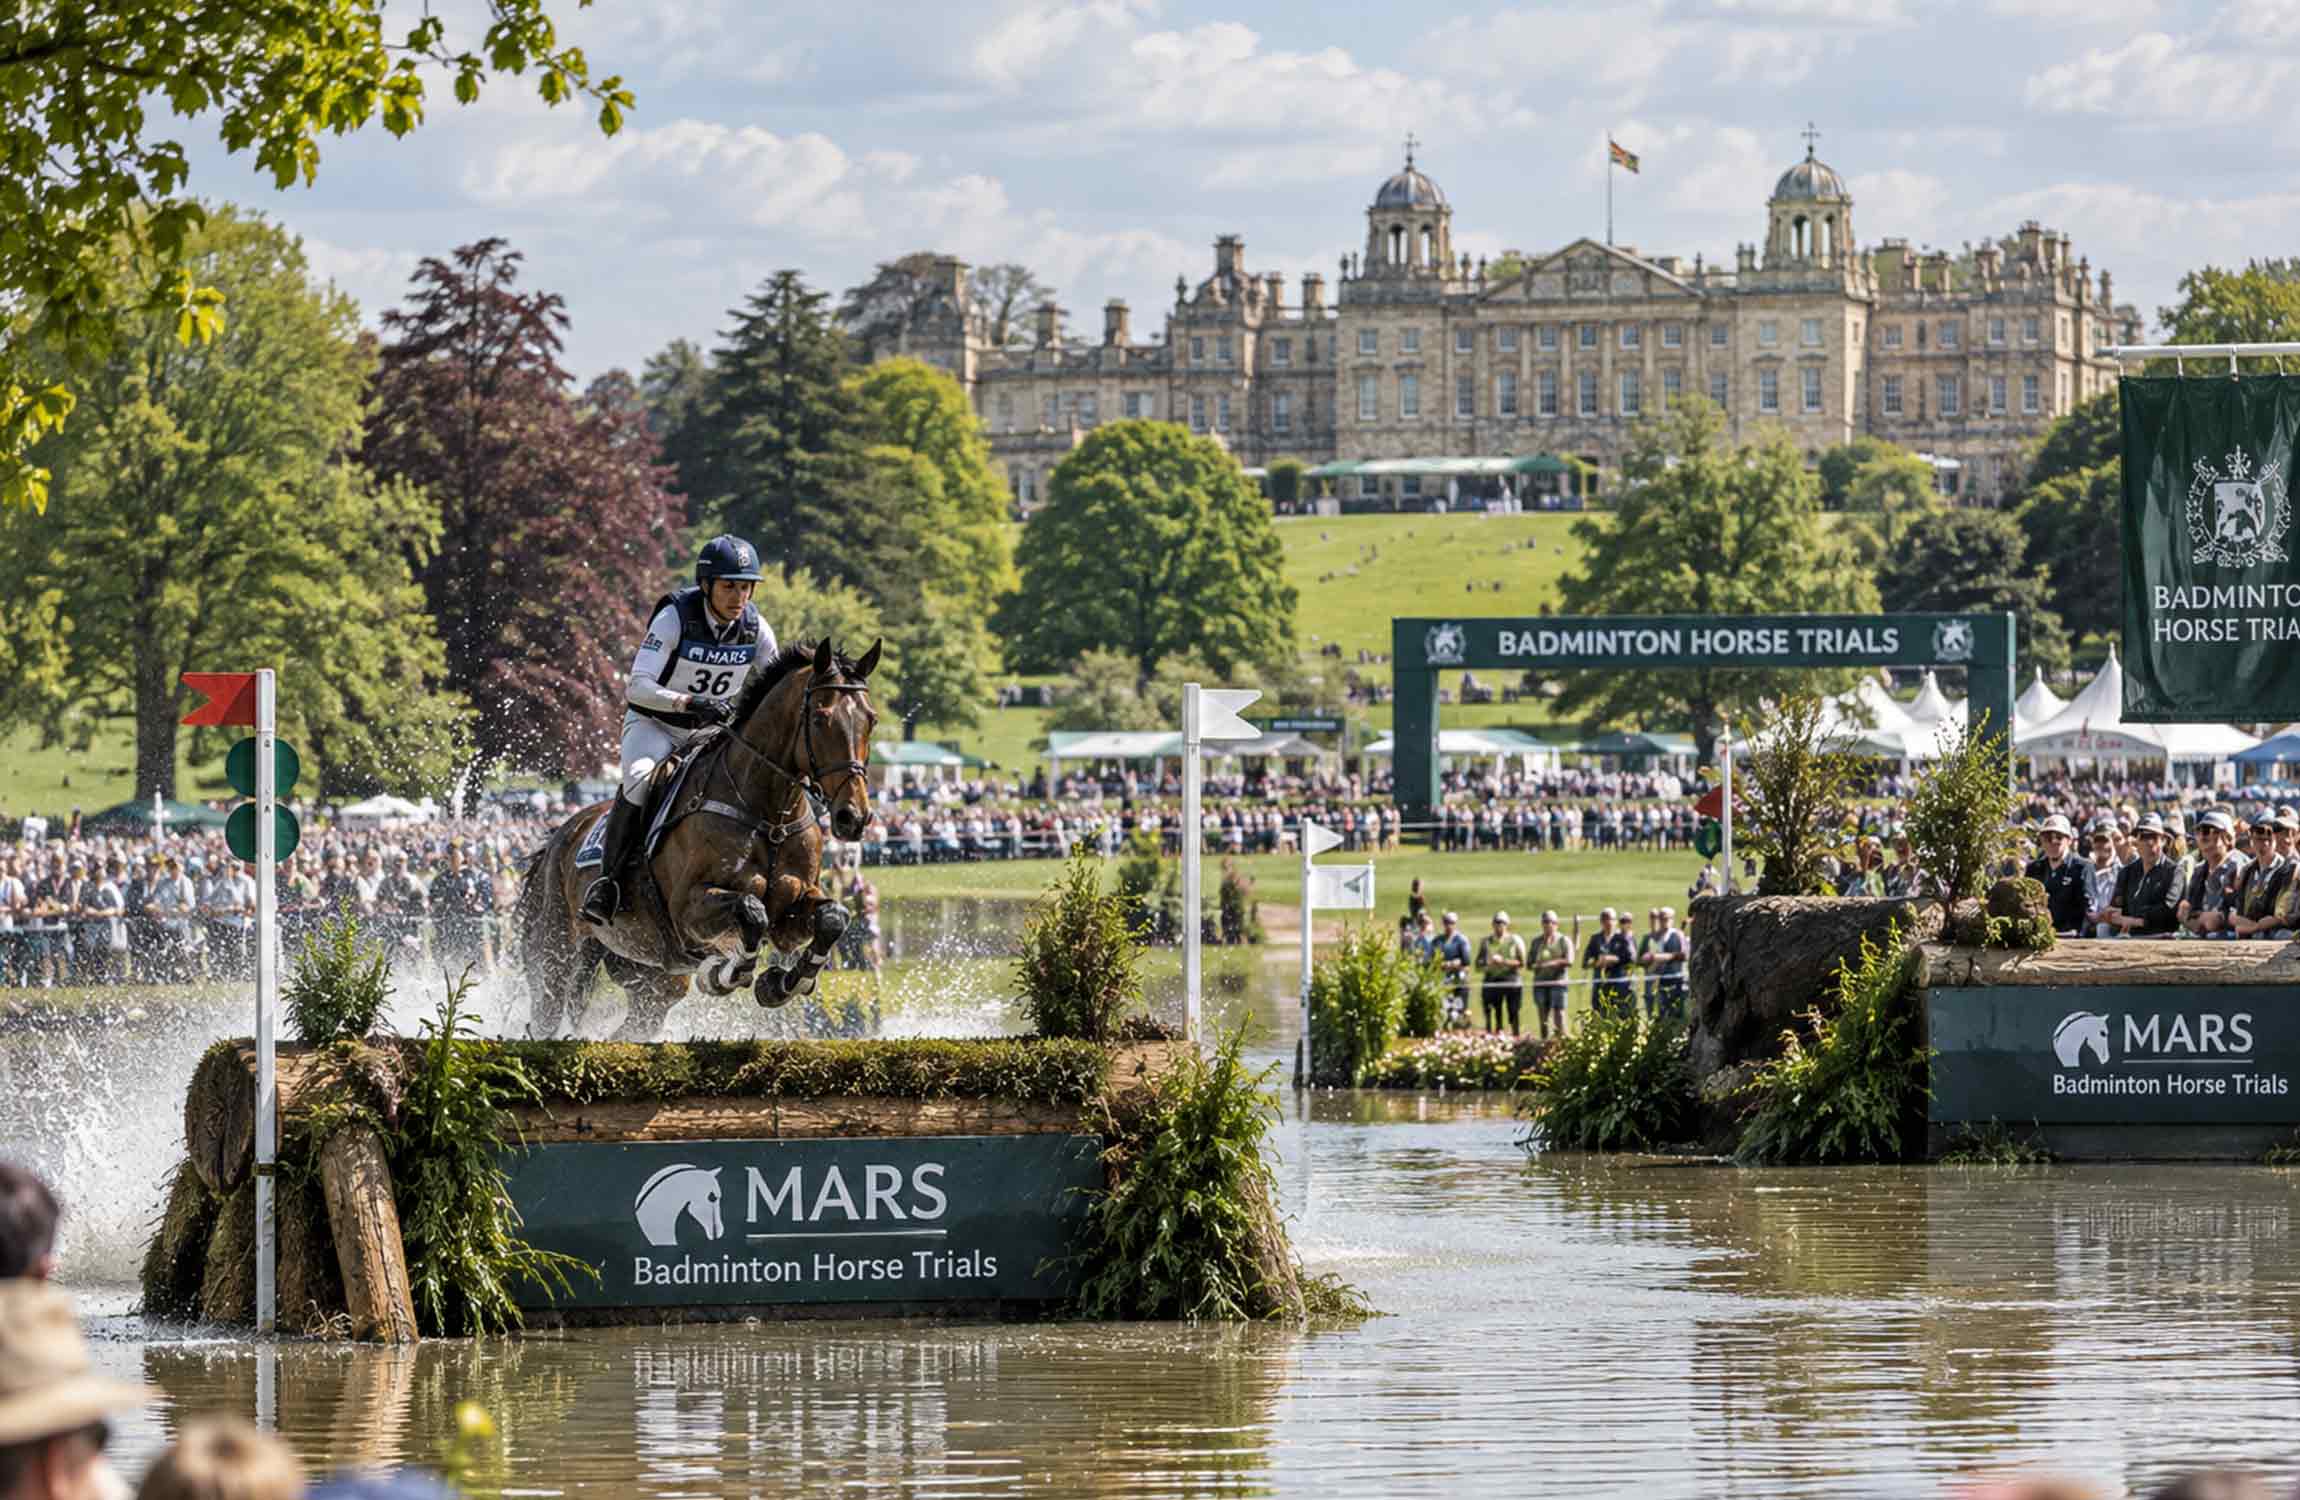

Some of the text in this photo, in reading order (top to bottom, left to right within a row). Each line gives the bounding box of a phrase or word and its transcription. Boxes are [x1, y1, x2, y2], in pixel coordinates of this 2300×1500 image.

[2154, 584, 2300, 609] BADMINTO
[1499, 628, 1899, 656] BADMINTON HORSE TRIALS
[2154, 617, 2300, 642] HORSE TRIA
[705, 650, 747, 664] MARS
[688, 669, 734, 696] 36
[2123, 1013, 2254, 1053] MARS
[2053, 1074, 2289, 1095] Badminton Horse Trials
[745, 1162, 948, 1223] MARS
[633, 1249, 998, 1285] Badminton Horse Trials
